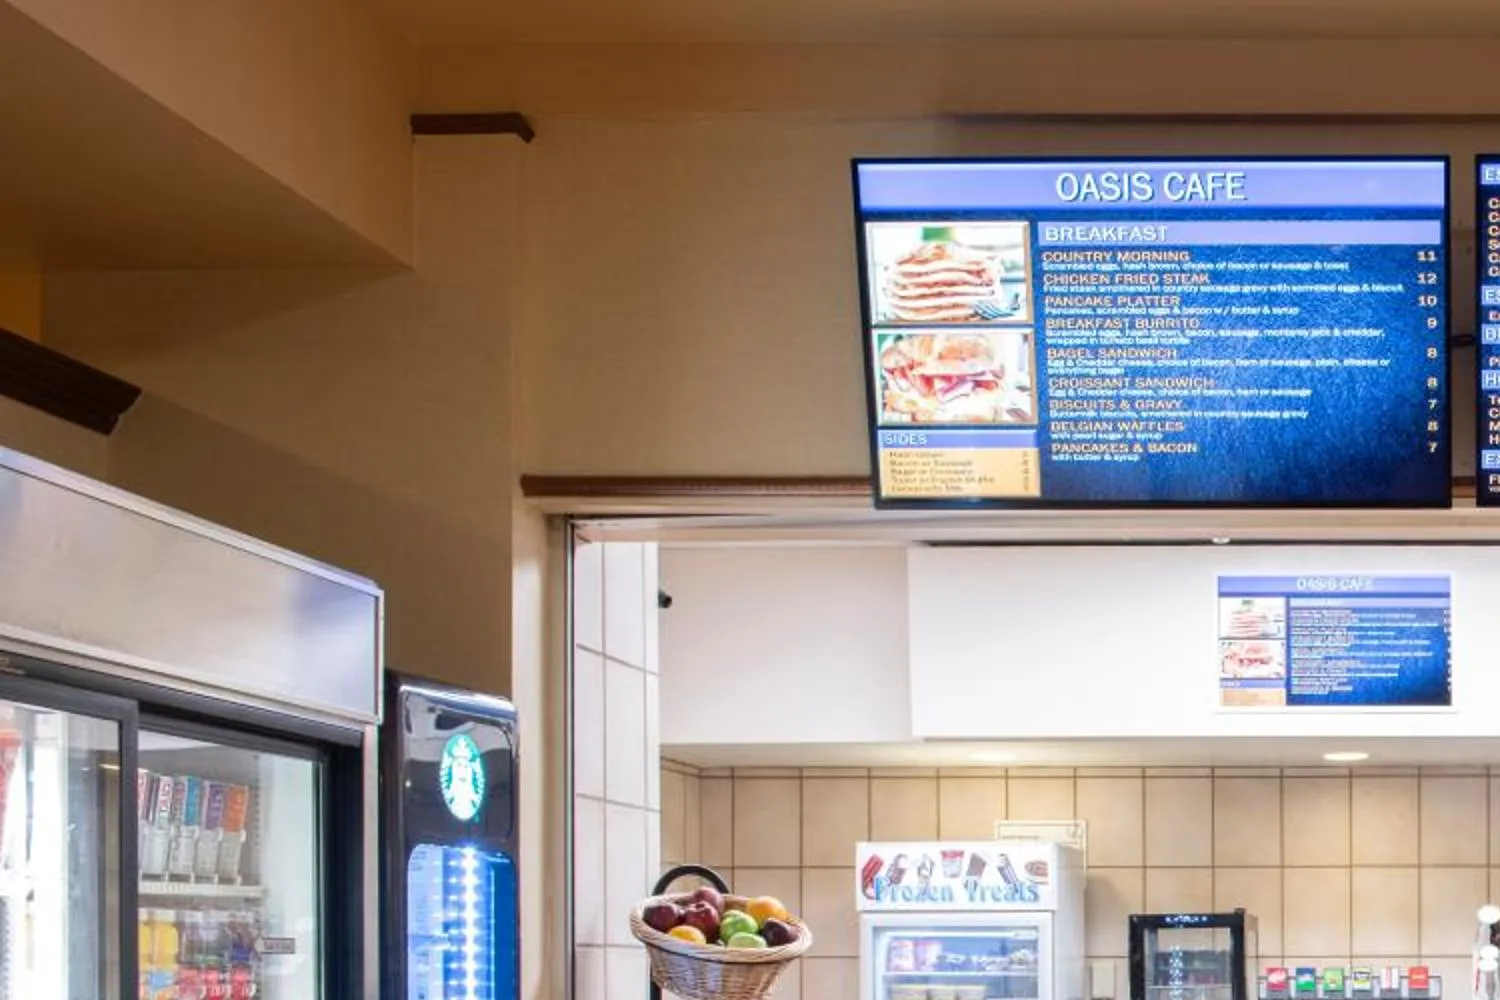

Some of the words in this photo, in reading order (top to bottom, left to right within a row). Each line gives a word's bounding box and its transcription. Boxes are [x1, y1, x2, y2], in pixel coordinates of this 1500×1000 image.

[1056, 172, 1154, 202] OASIS
[1163, 172, 1247, 202] CAFE
[1045, 226, 1168, 241] BREAKFAST
[1043, 251, 1112, 262] COUNTRY
[1117, 251, 1190, 262] MORNING
[1043, 273, 1110, 285] CHICKEN
[1115, 273, 1159, 285] FRIED
[1163, 273, 1210, 285] STEAK
[1417, 273, 1437, 285] 12
[1045, 296, 1112, 306] PANCAKE
[1117, 296, 1181, 306] PLATTER
[1418, 296, 1437, 306] 10
[1045, 318, 1130, 329] BREAKFAST
[1135, 318, 1200, 329] BURRITO
[1048, 348, 1094, 358] BAGEL
[1099, 348, 1177, 358] SANDWICH
[1049, 377, 1131, 389] CROISSANT
[1135, 377, 1215, 389] SANDWICH
[1050, 400, 1114, 410] BISCUITS
[1135, 400, 1183, 410] GRAVY
[1427, 400, 1438, 410] 7
[886, 433, 927, 445] SIDES
[1052, 443, 1129, 453] PANCAKES
[1148, 443, 1197, 453] BACON
[1427, 443, 1438, 453] 7
[875, 876, 954, 902] Frozen
[964, 875, 1041, 902] Treats
